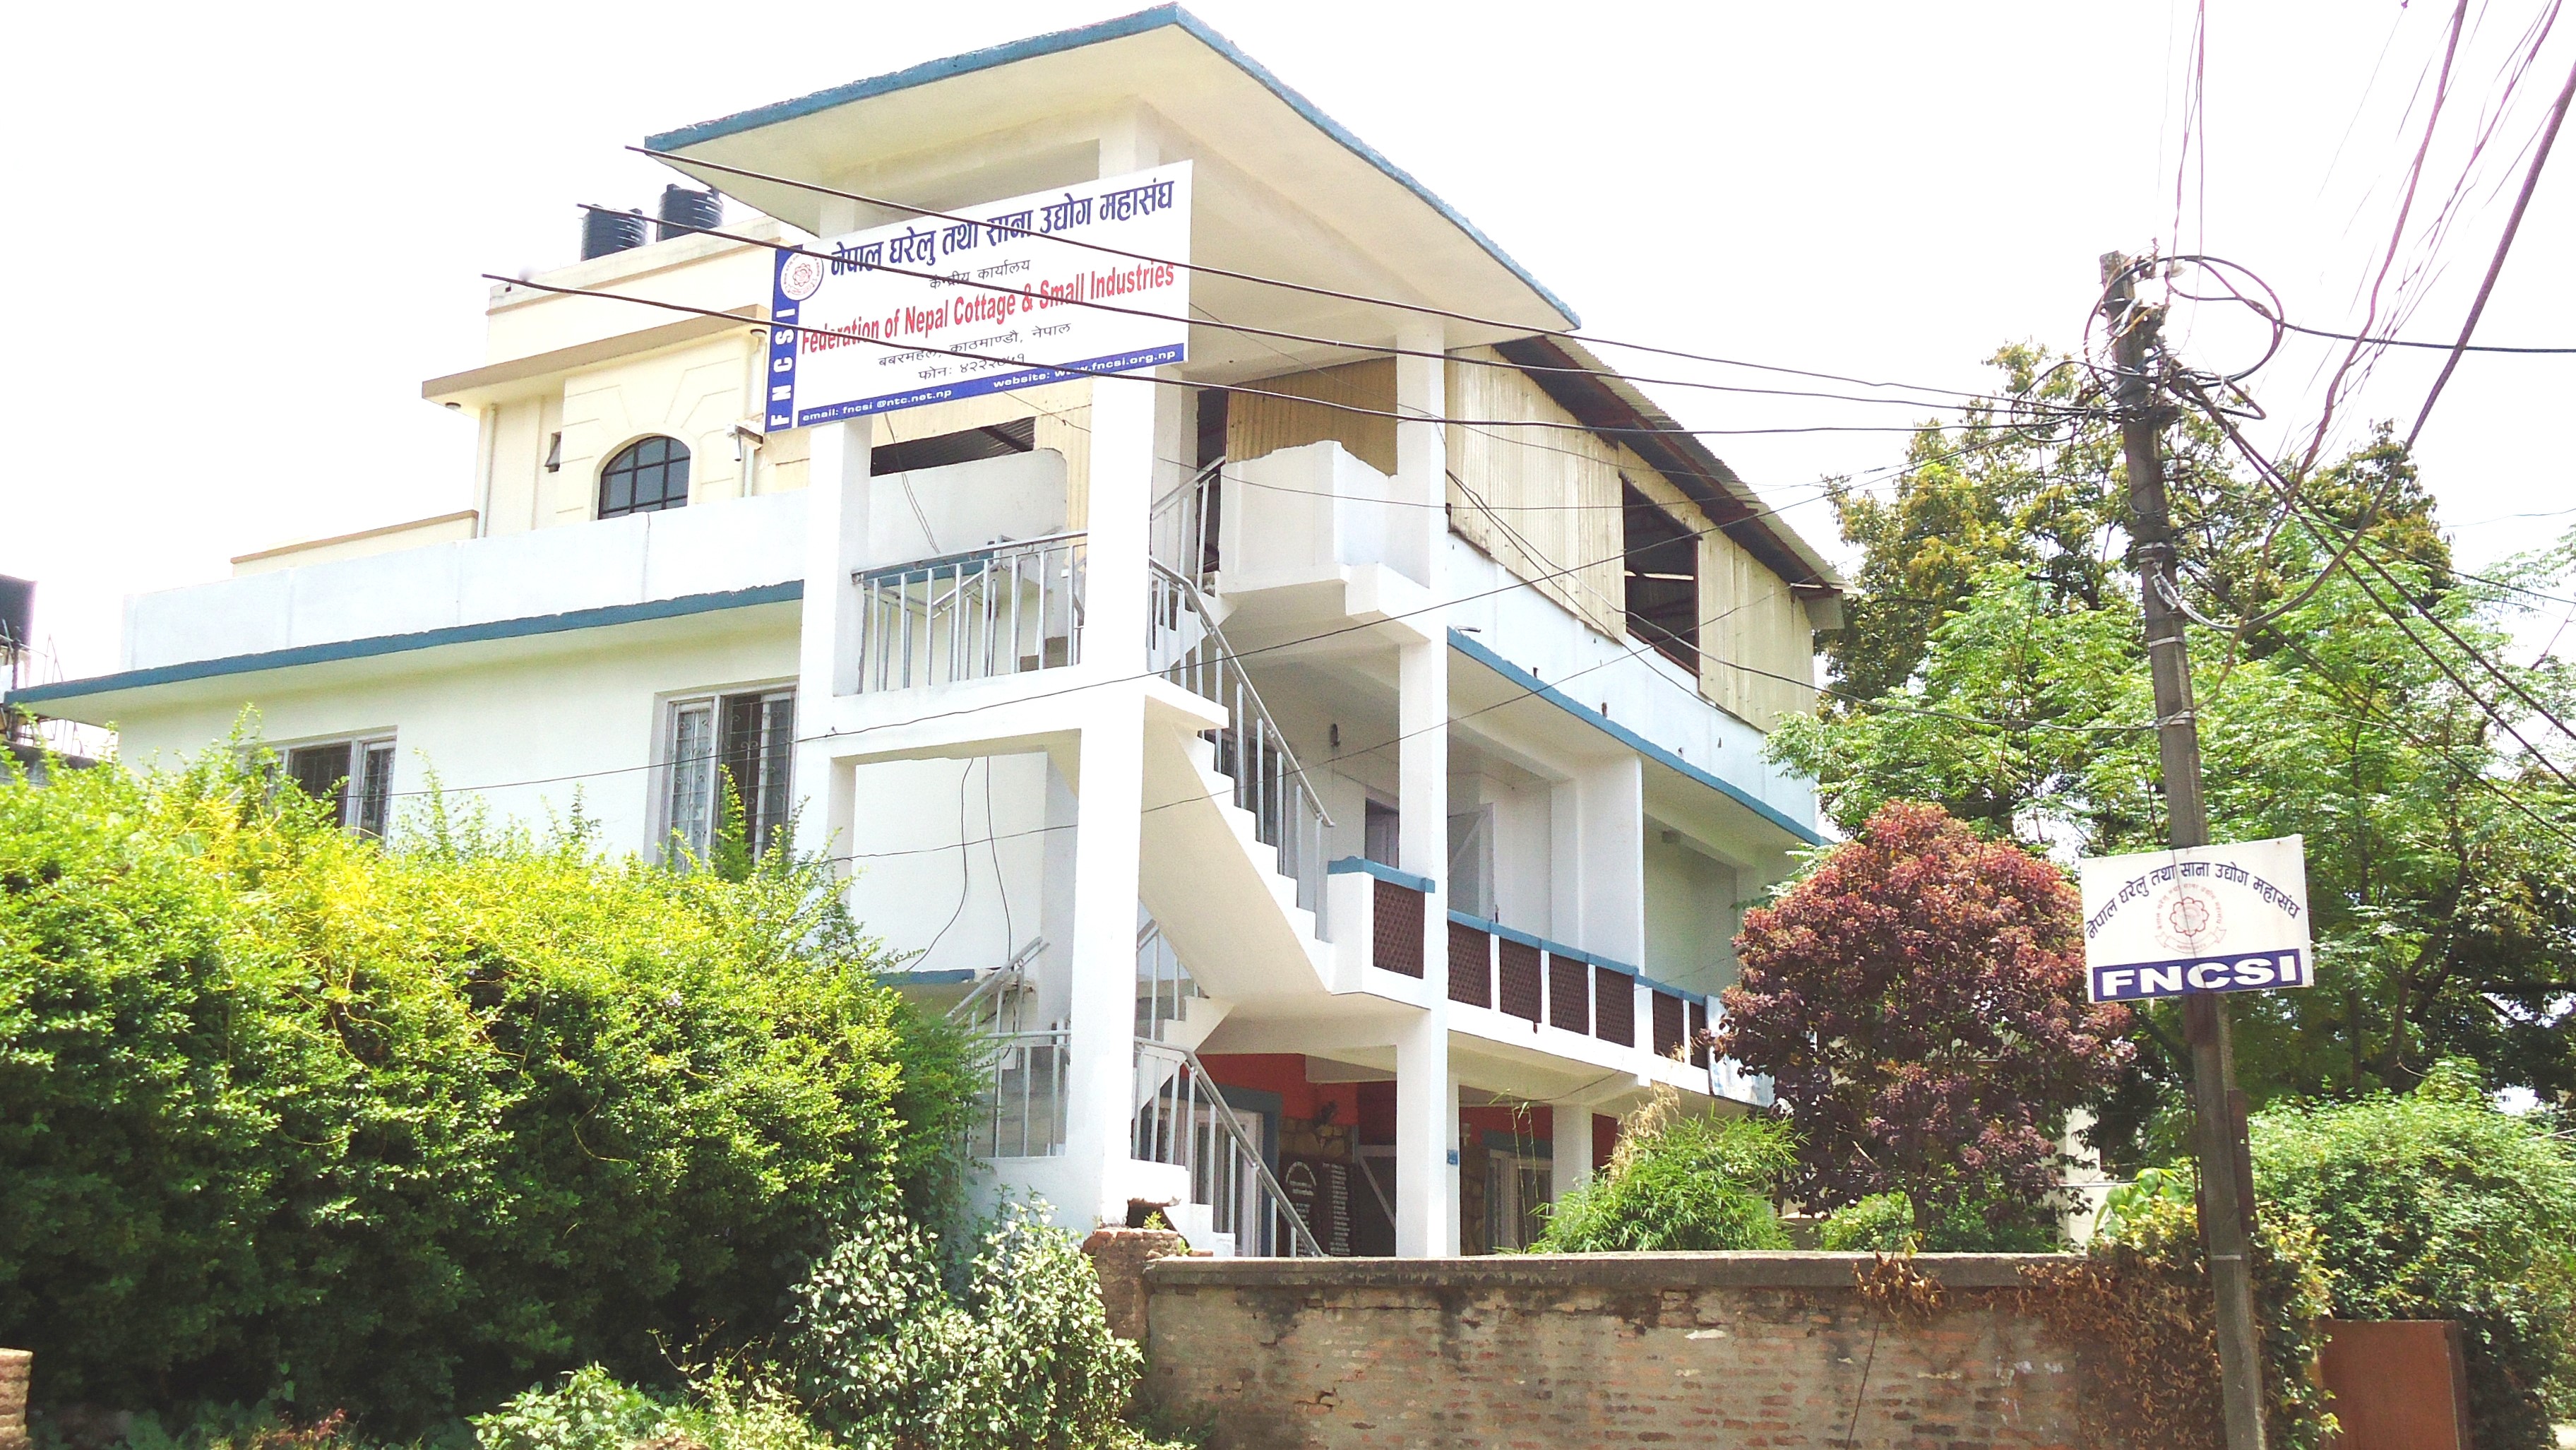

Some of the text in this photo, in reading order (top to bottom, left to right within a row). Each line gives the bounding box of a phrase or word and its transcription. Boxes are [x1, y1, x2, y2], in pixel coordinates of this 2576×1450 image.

[831, 242, 884, 275] नेपाल
[889, 226, 936, 266] घरेलु
[943, 220, 978, 255] तथा
[986, 210, 1034, 246] साना
[1039, 193, 1093, 234] उद्योग
[1099, 177, 1175, 221] महासंघ
[977, 259, 1030, 280] कार्यालय
[801, 259, 1174, 355] Federation of Nepal Cottage & Small Industries
[1031, 323, 1071, 338] नेपाल
[994, 372, 1050, 388] website:
[802, 408, 839, 422] email:
[843, 402, 873, 415] fncsi
[2086, 898, 2118, 939] नेपाल
[2118, 876, 2149, 903] घरेलु
[2149, 864, 2176, 886] तथा
[2179, 862, 2211, 877] साना
[2215, 861, 2250, 886] उद्योग
[2253, 876, 2301, 919] महासंघ
[2101, 955, 2296, 997] FNCSI
